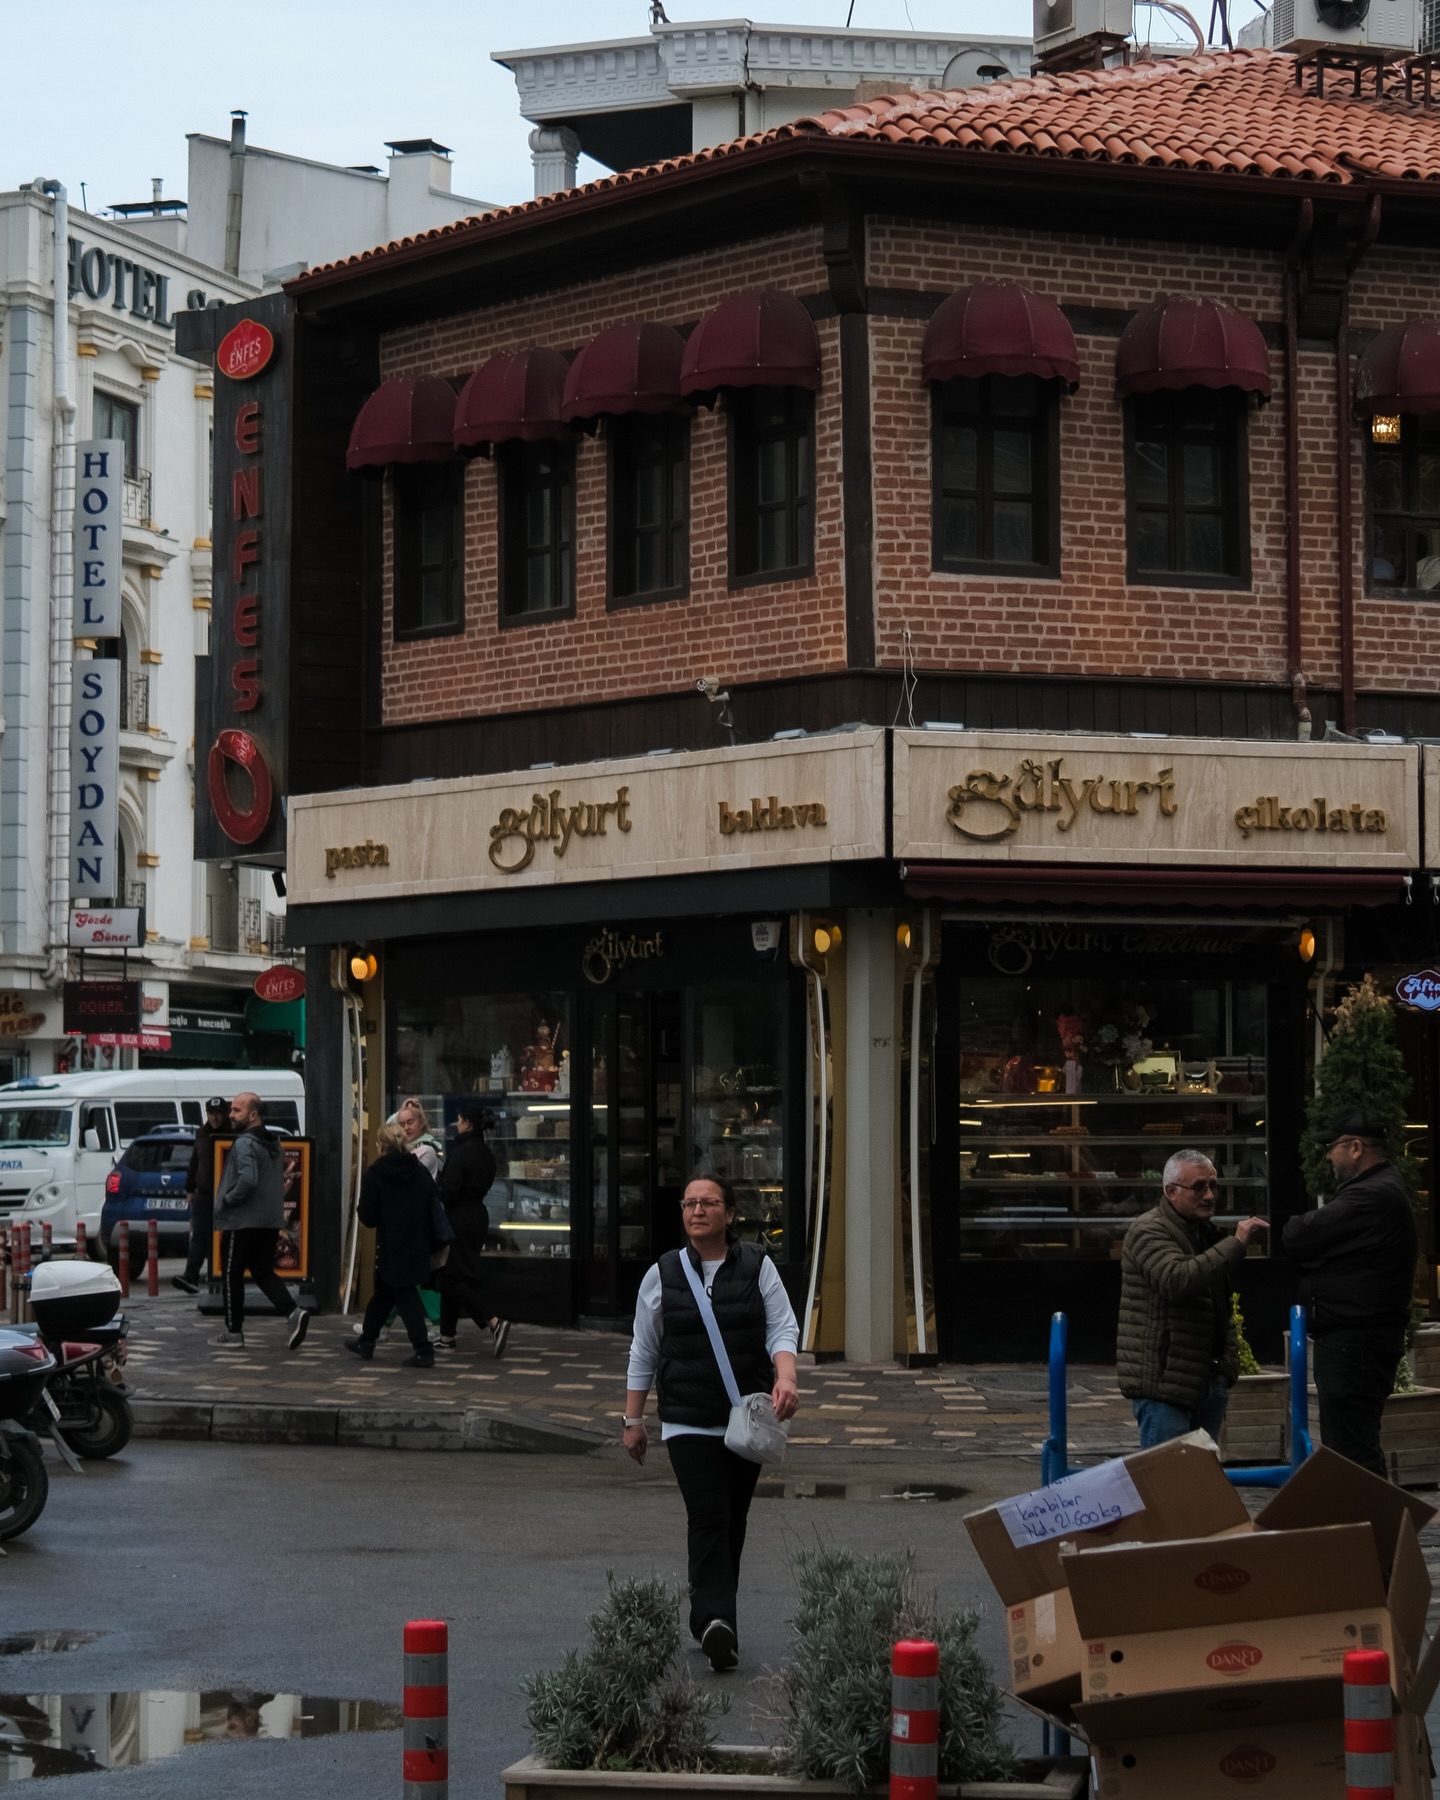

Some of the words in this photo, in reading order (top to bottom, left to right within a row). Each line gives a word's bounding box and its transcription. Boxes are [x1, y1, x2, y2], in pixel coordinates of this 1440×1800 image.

[229, 337, 262, 369] ENFES
[82, 452, 110, 625] HOTEL
[77, 672, 106, 884] SOYDAN
[945, 757, 1178, 842] gülyurt
[1234, 796, 1387, 839] çikolata
[324, 839, 390, 879] pasta
[488, 786, 632, 873] gülyurt
[717, 795, 828, 837] baklava
[75, 912, 113, 928] Gözde
[92, 930, 131, 942] Döner
[266, 978, 296, 995] ENFES
[0, 1161, 23, 1169] PATA
[1211, 1648, 1258, 1668] DANET
